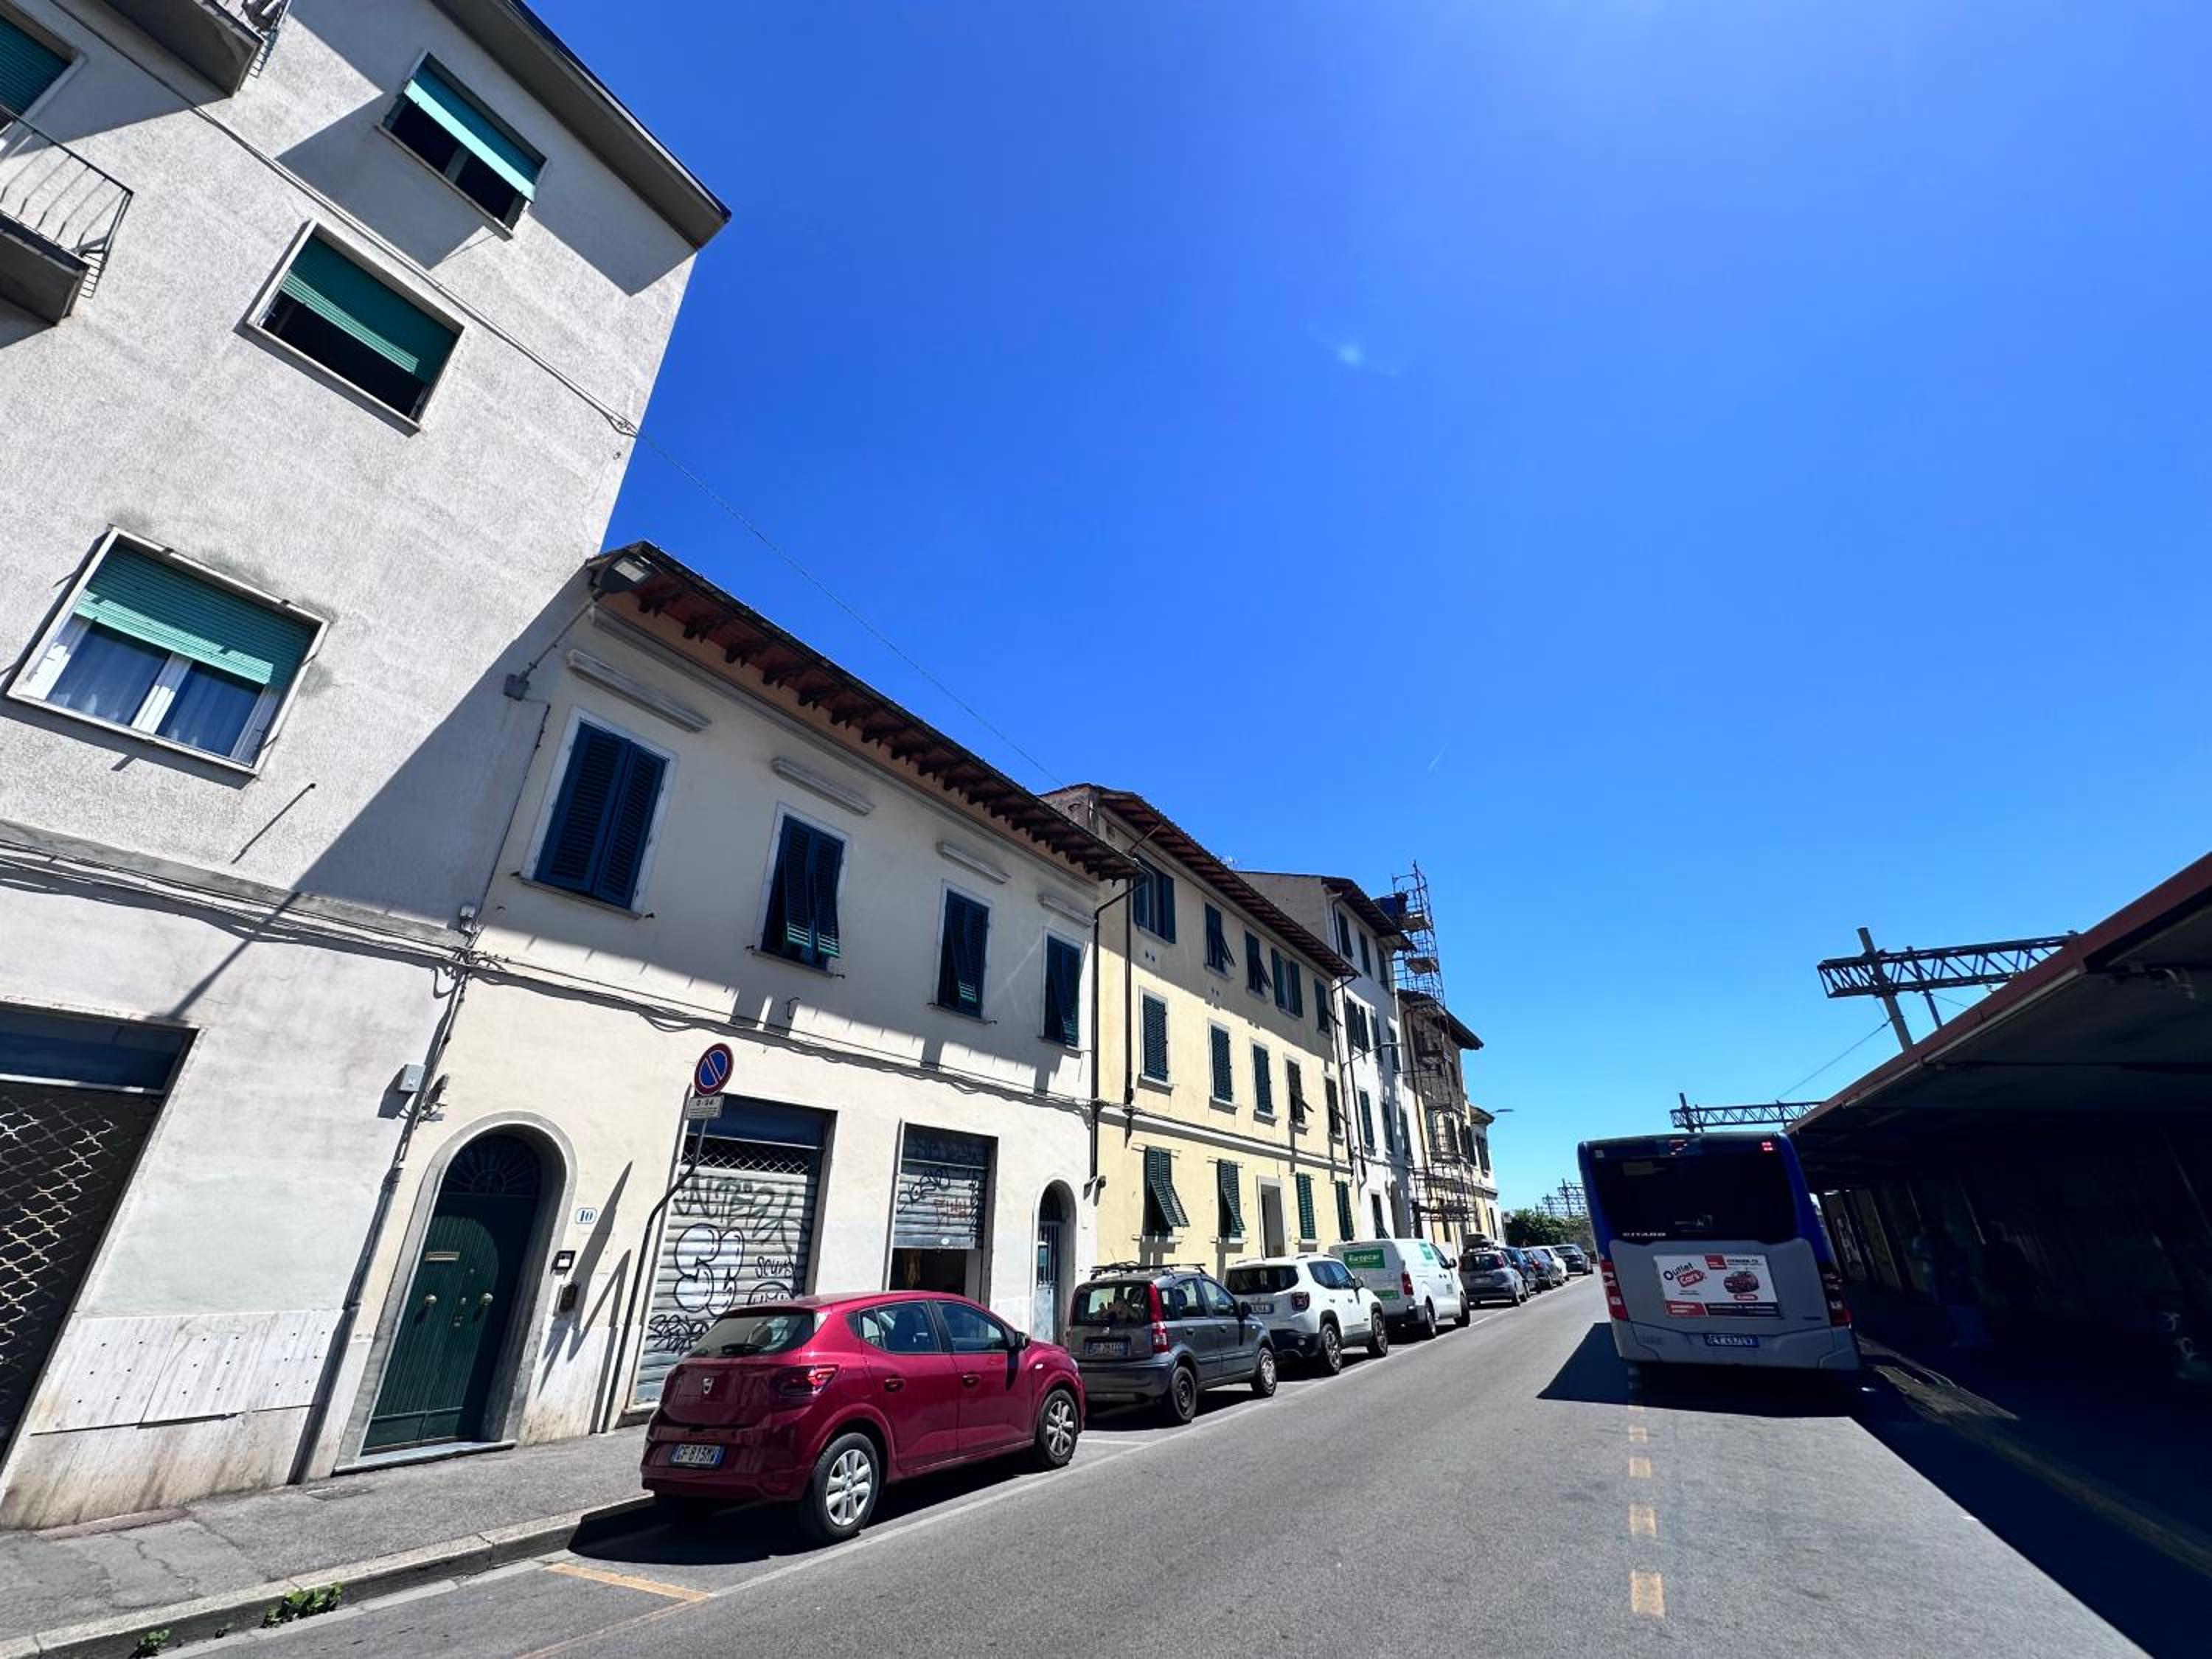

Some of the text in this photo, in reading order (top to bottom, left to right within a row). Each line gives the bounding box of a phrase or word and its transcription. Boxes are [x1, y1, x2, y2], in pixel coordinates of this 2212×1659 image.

[580, 1210, 594, 1221] 10
[1663, 1262, 1694, 1281] Outlet
[1680, 1273, 1701, 1284] Cars
